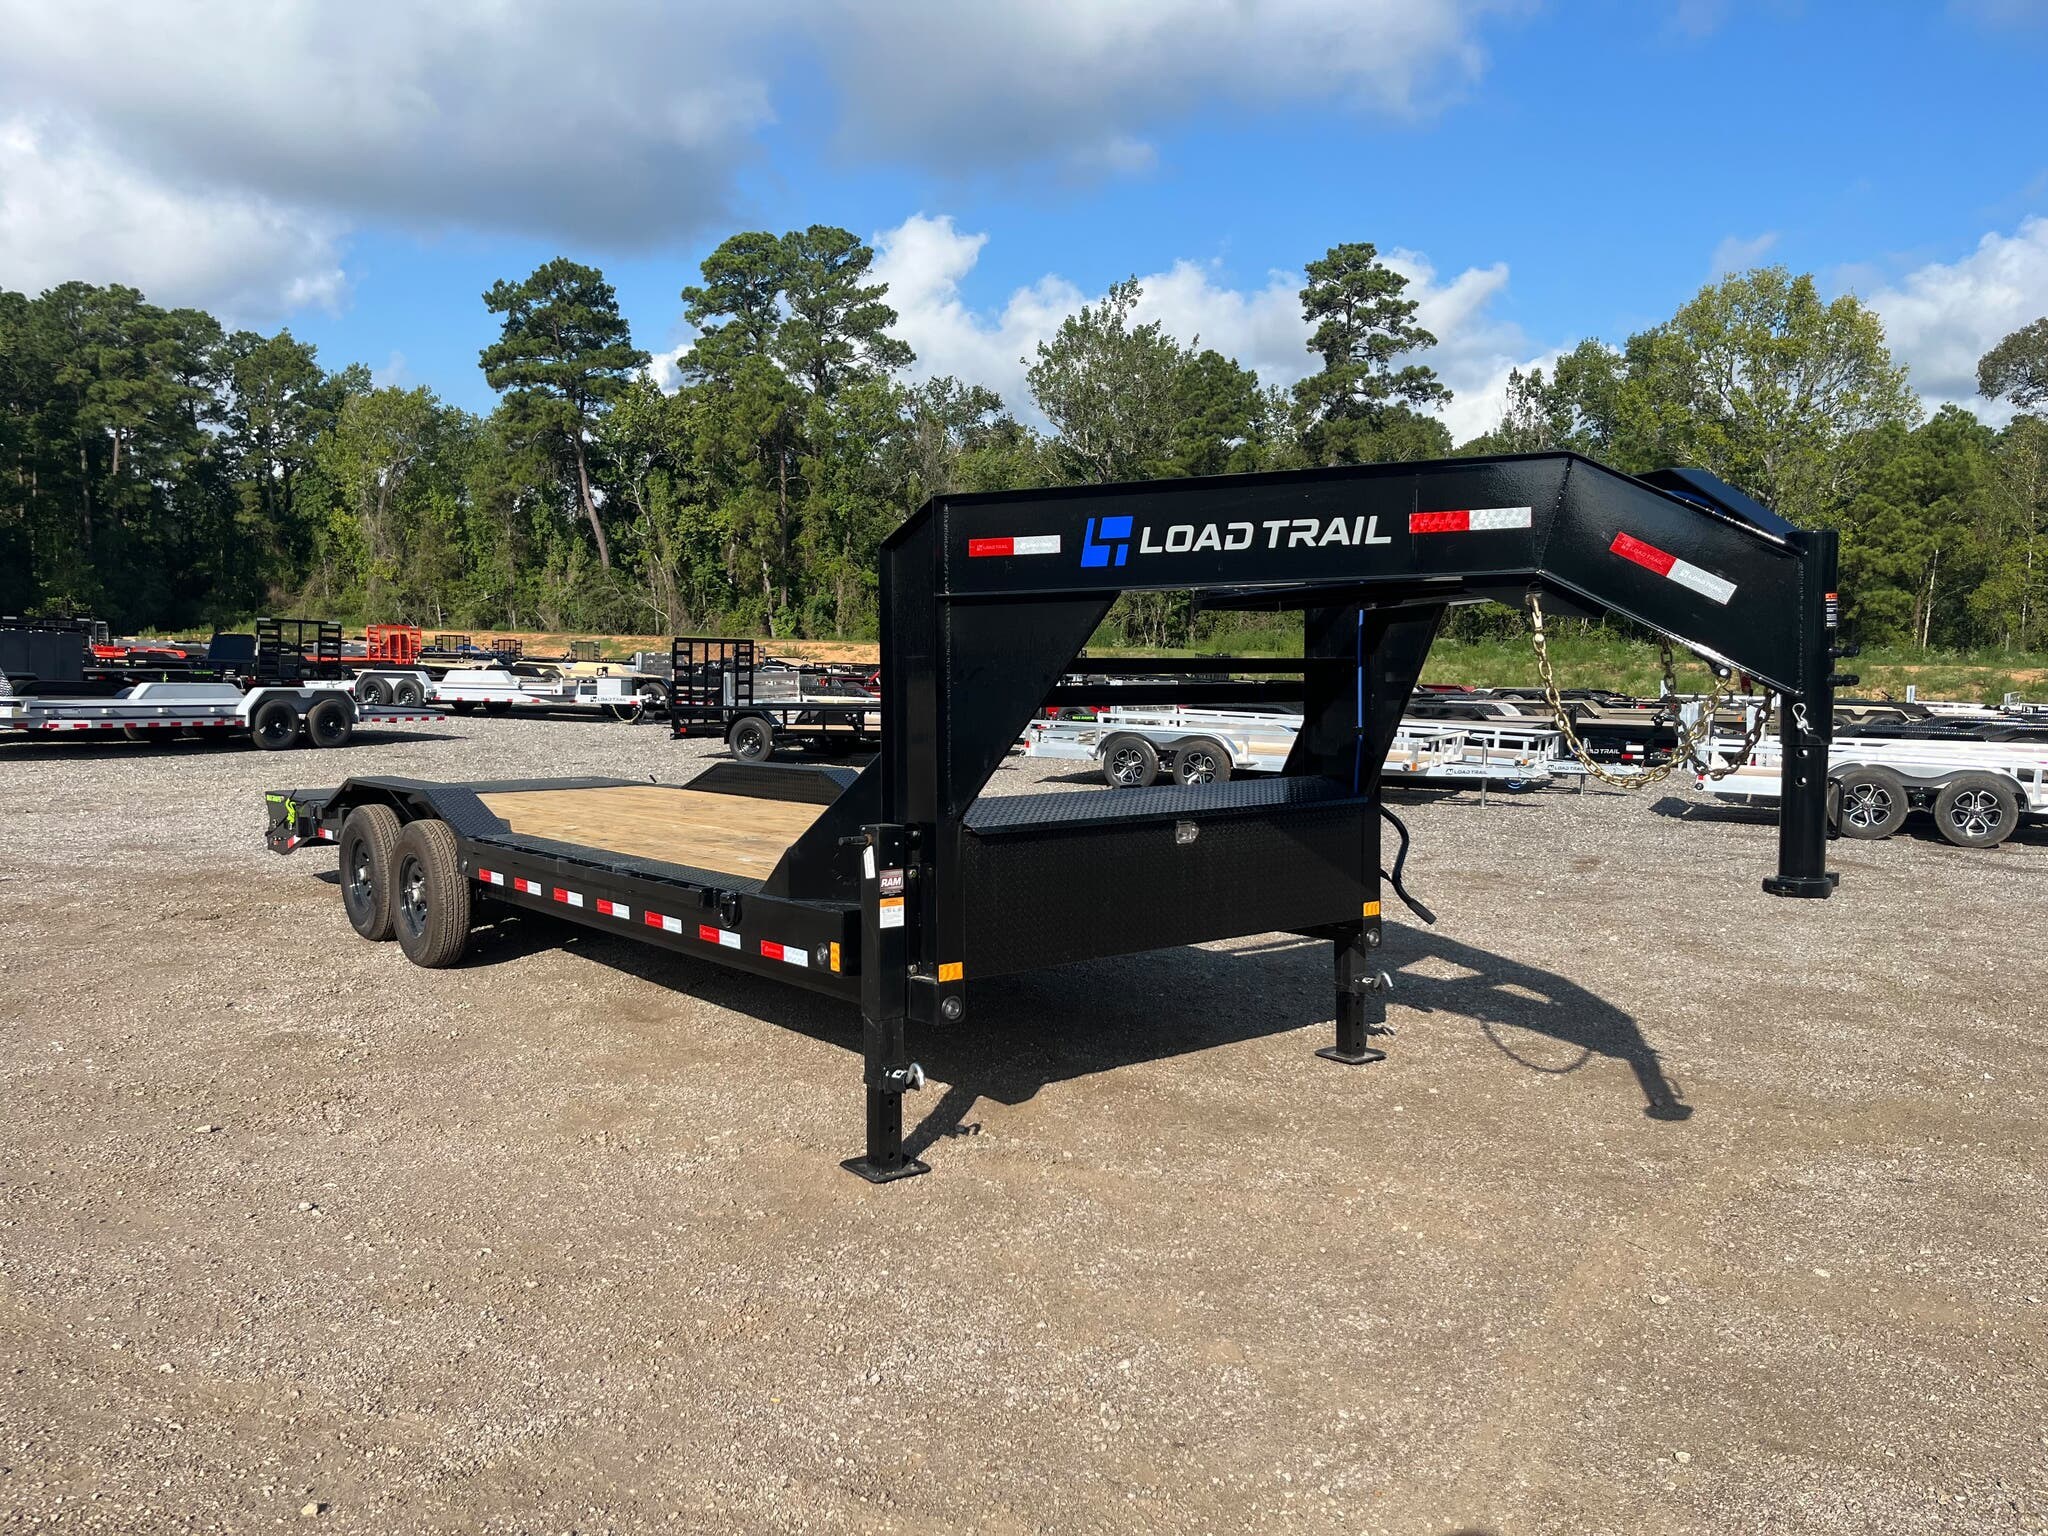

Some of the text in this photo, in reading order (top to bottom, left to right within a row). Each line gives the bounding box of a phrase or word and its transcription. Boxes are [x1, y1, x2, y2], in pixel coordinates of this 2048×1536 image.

[1139, 515, 1392, 554] LOAD TRAIL
[881, 876, 902, 888] RAM
